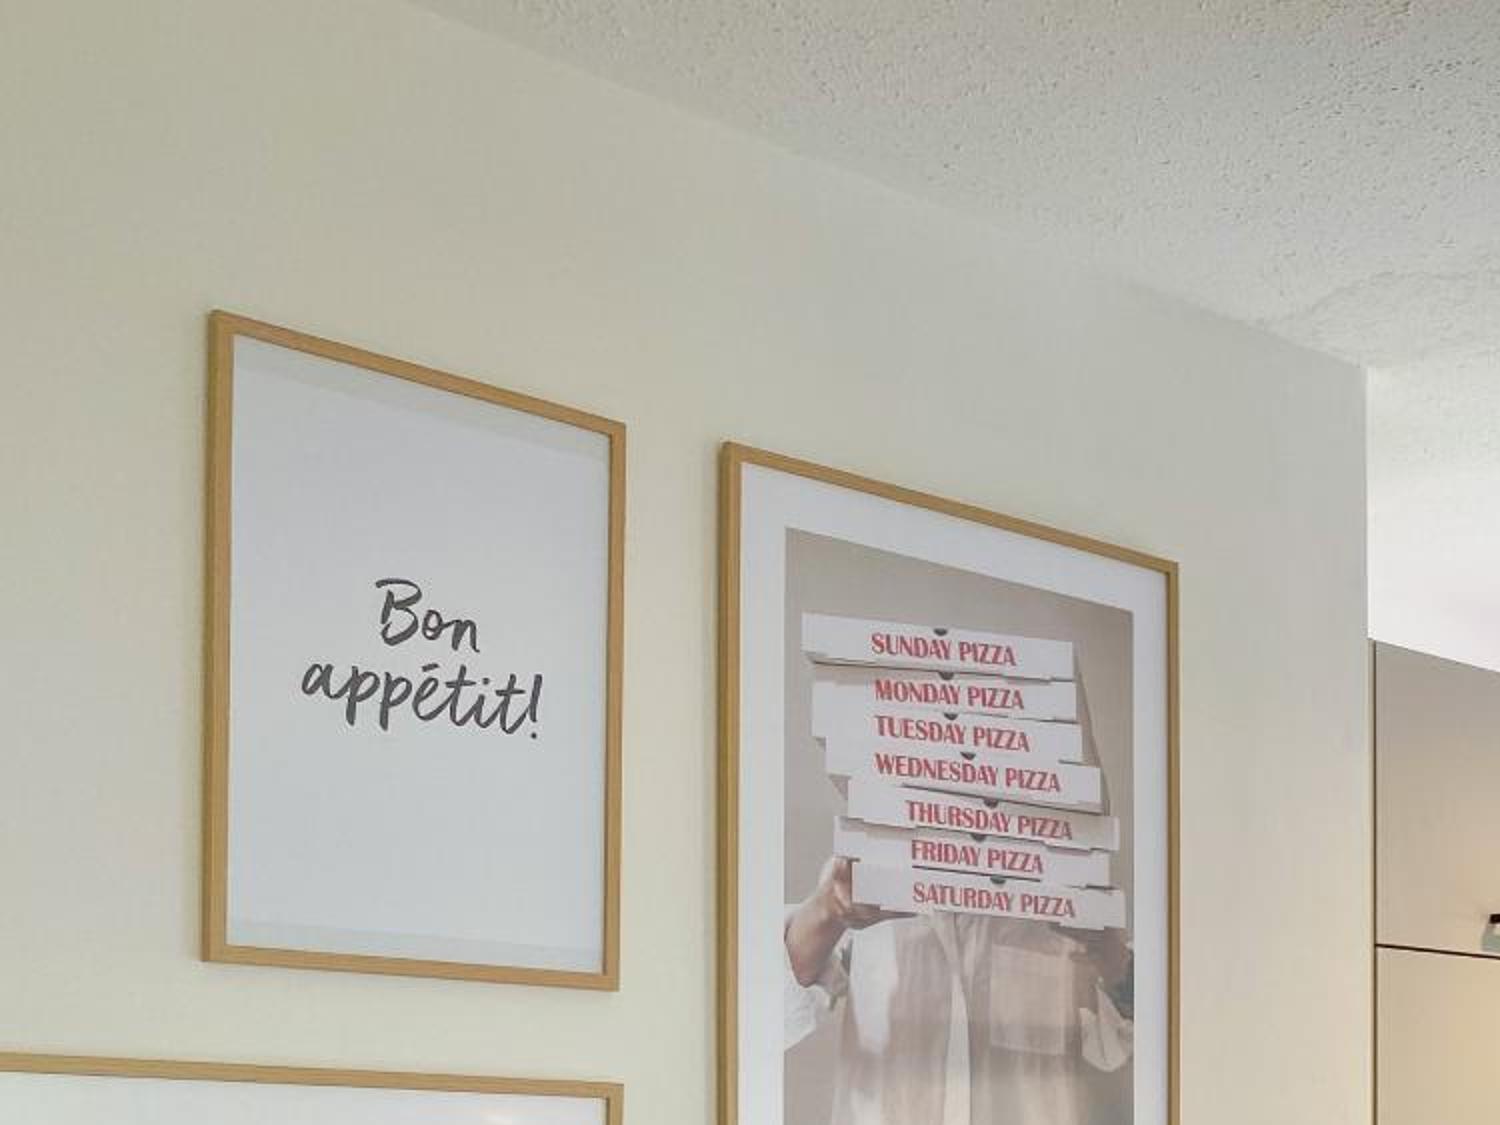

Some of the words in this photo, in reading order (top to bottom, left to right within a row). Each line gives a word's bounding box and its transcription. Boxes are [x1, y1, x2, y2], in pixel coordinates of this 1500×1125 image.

[375, 578, 481, 654] Bon
[871, 633, 953, 661] SUNDAY
[959, 642, 1017, 667] PIZZA
[301, 662, 543, 740] appétit!
[874, 679, 962, 706] MONDAY
[968, 686, 1024, 711] PIZZA
[875, 715, 967, 746] TUESDAY
[972, 727, 1031, 752] PIZZA
[874, 753, 999, 787] WEDNESDAY
[1005, 768, 1061, 793] PIZZA
[906, 801, 1011, 833] THURSDAY
[1018, 815, 1073, 841] PIZZA
[911, 839, 981, 866] FRIDAY
[986, 849, 1044, 874] PIZZA
[913, 884, 1012, 913] SATURDAY
[1019, 894, 1076, 918] PIZZA
